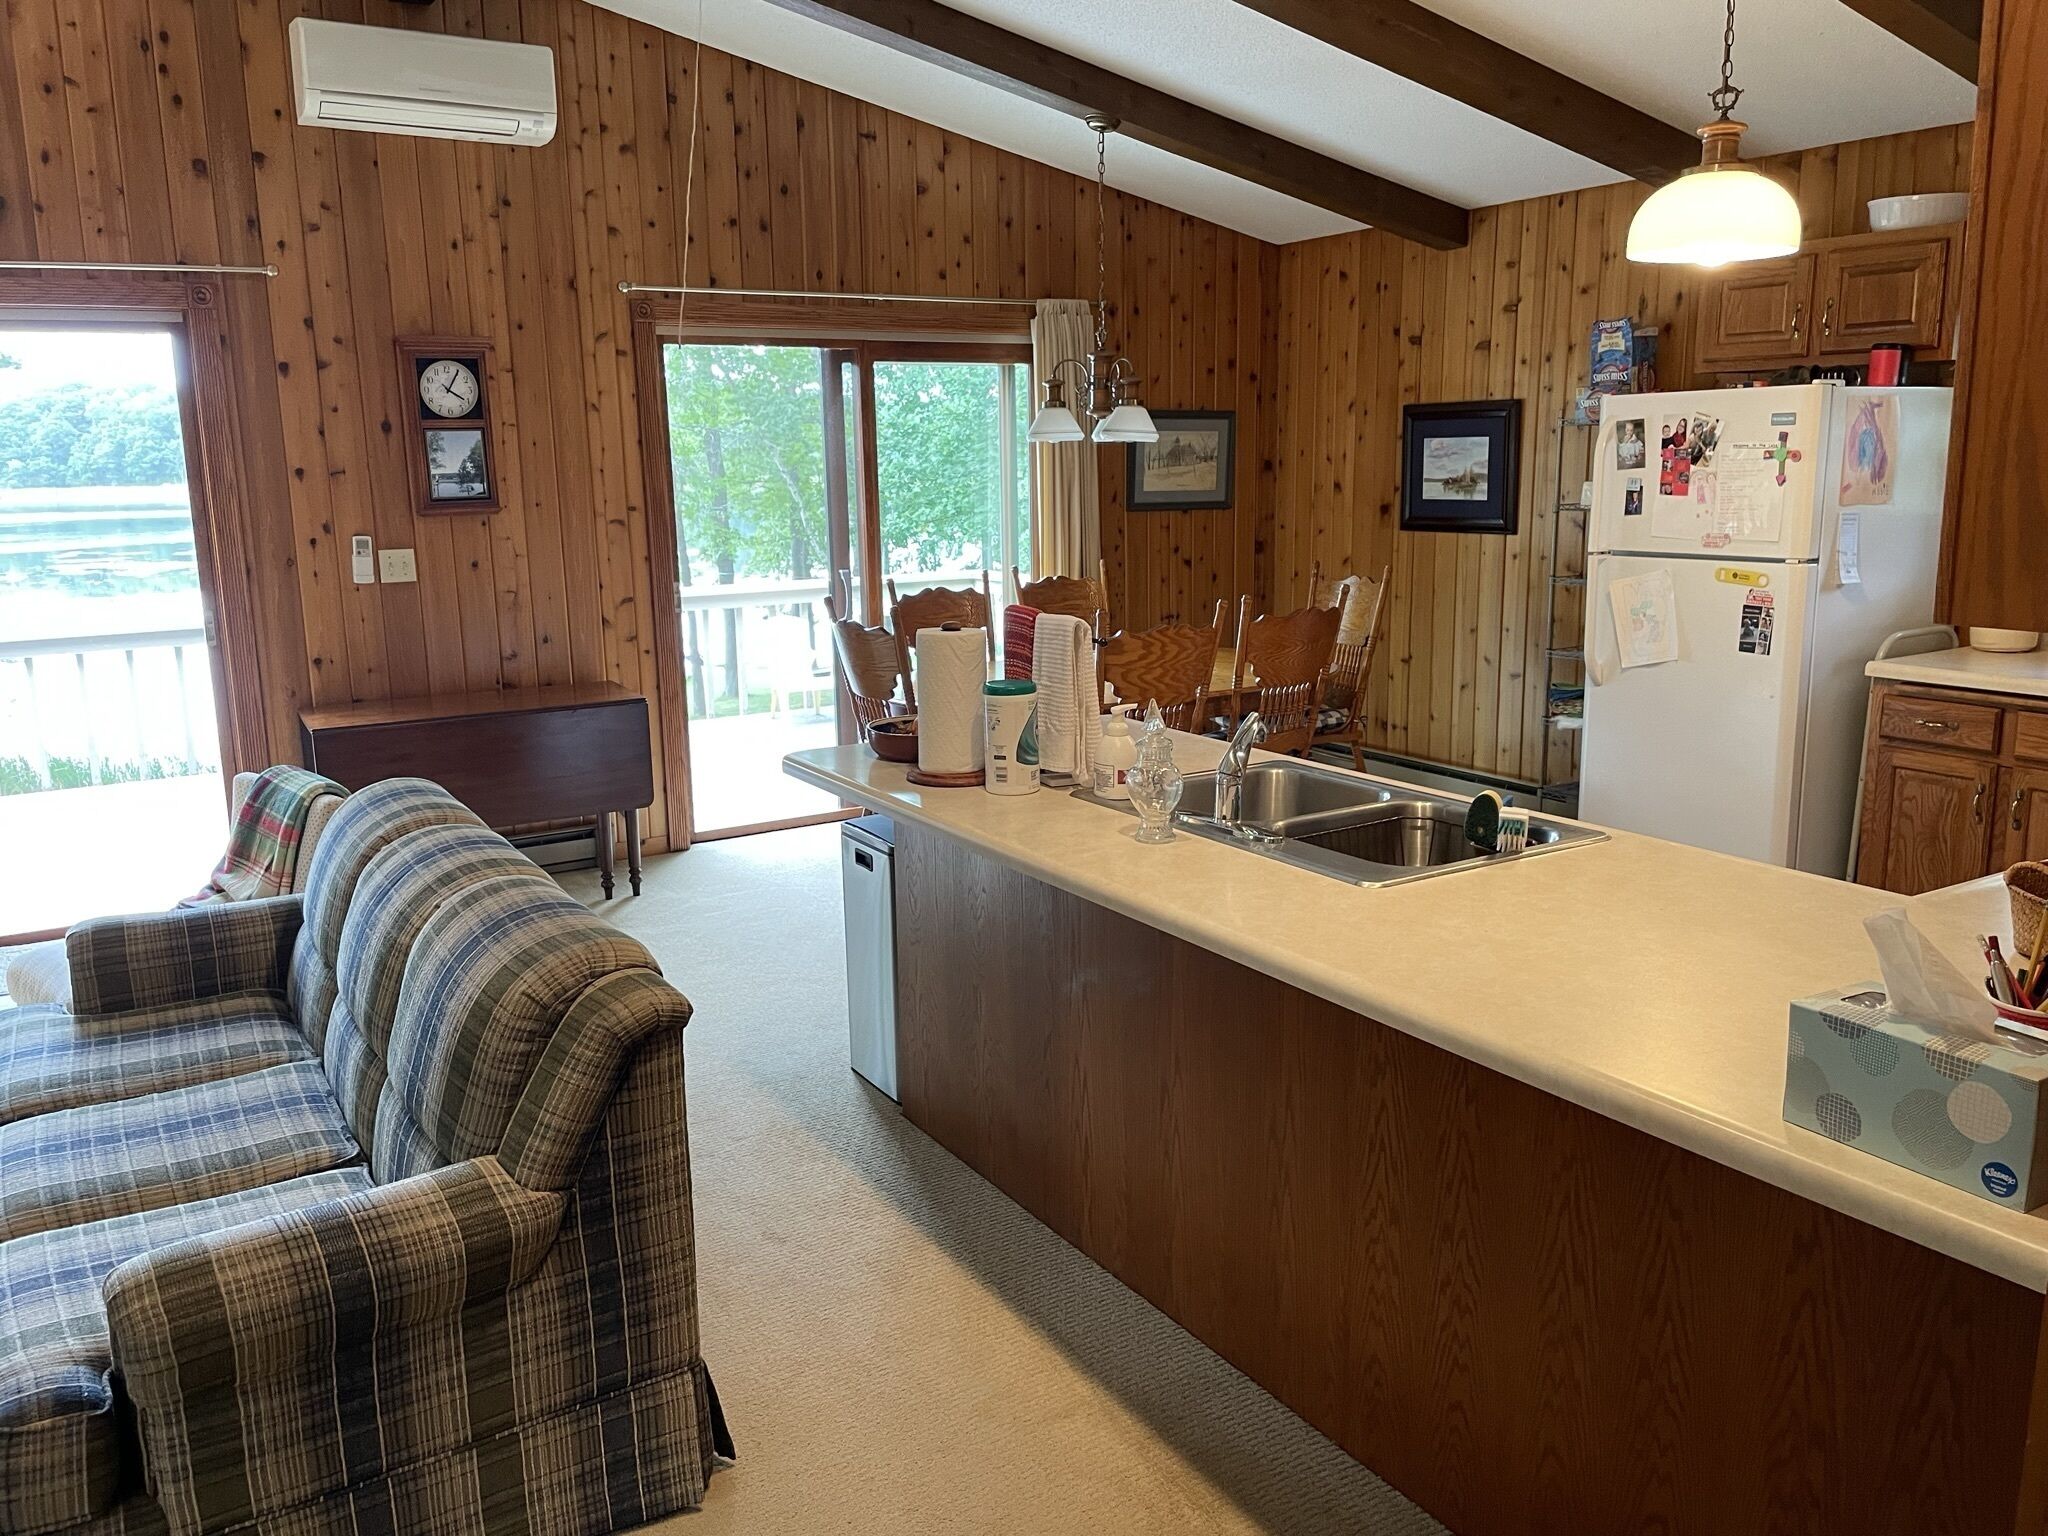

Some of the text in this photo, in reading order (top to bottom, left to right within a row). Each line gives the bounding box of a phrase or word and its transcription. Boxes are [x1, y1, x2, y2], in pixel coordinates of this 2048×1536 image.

[433, 368, 439, 376] 11
[443, 365, 450, 373] 12
[426, 376, 434, 384] 10
[462, 375, 469, 384] 2
[423, 386, 430, 394] 9
[467, 386, 473, 394] 3
[428, 397, 434, 405] 8
[447, 408, 454, 416] 6
[459, 404, 465, 412] 5
